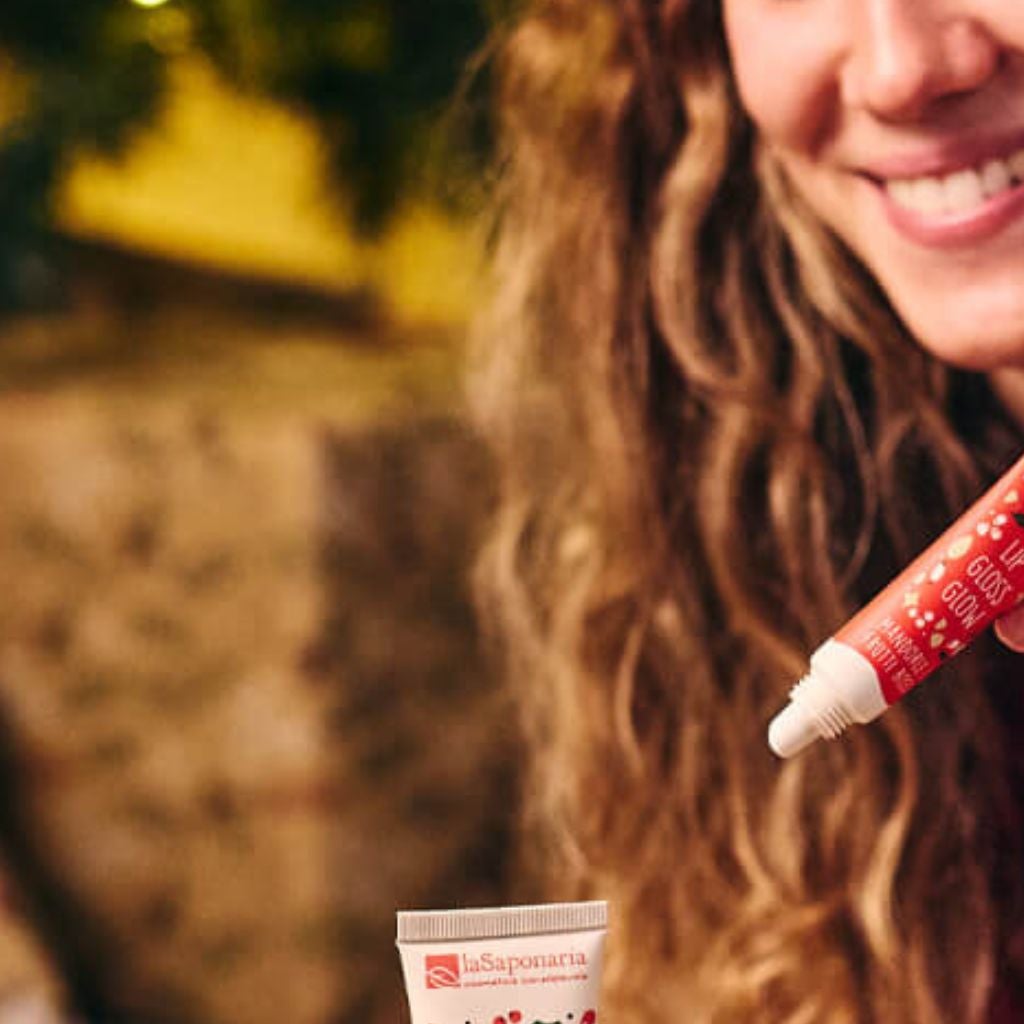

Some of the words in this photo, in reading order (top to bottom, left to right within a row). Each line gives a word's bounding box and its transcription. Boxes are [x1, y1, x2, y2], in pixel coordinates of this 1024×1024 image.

[967, 555, 1012, 606] GLOSS
[942, 581, 986, 630] GLOW
[463, 950, 587, 976] laSaponaria
